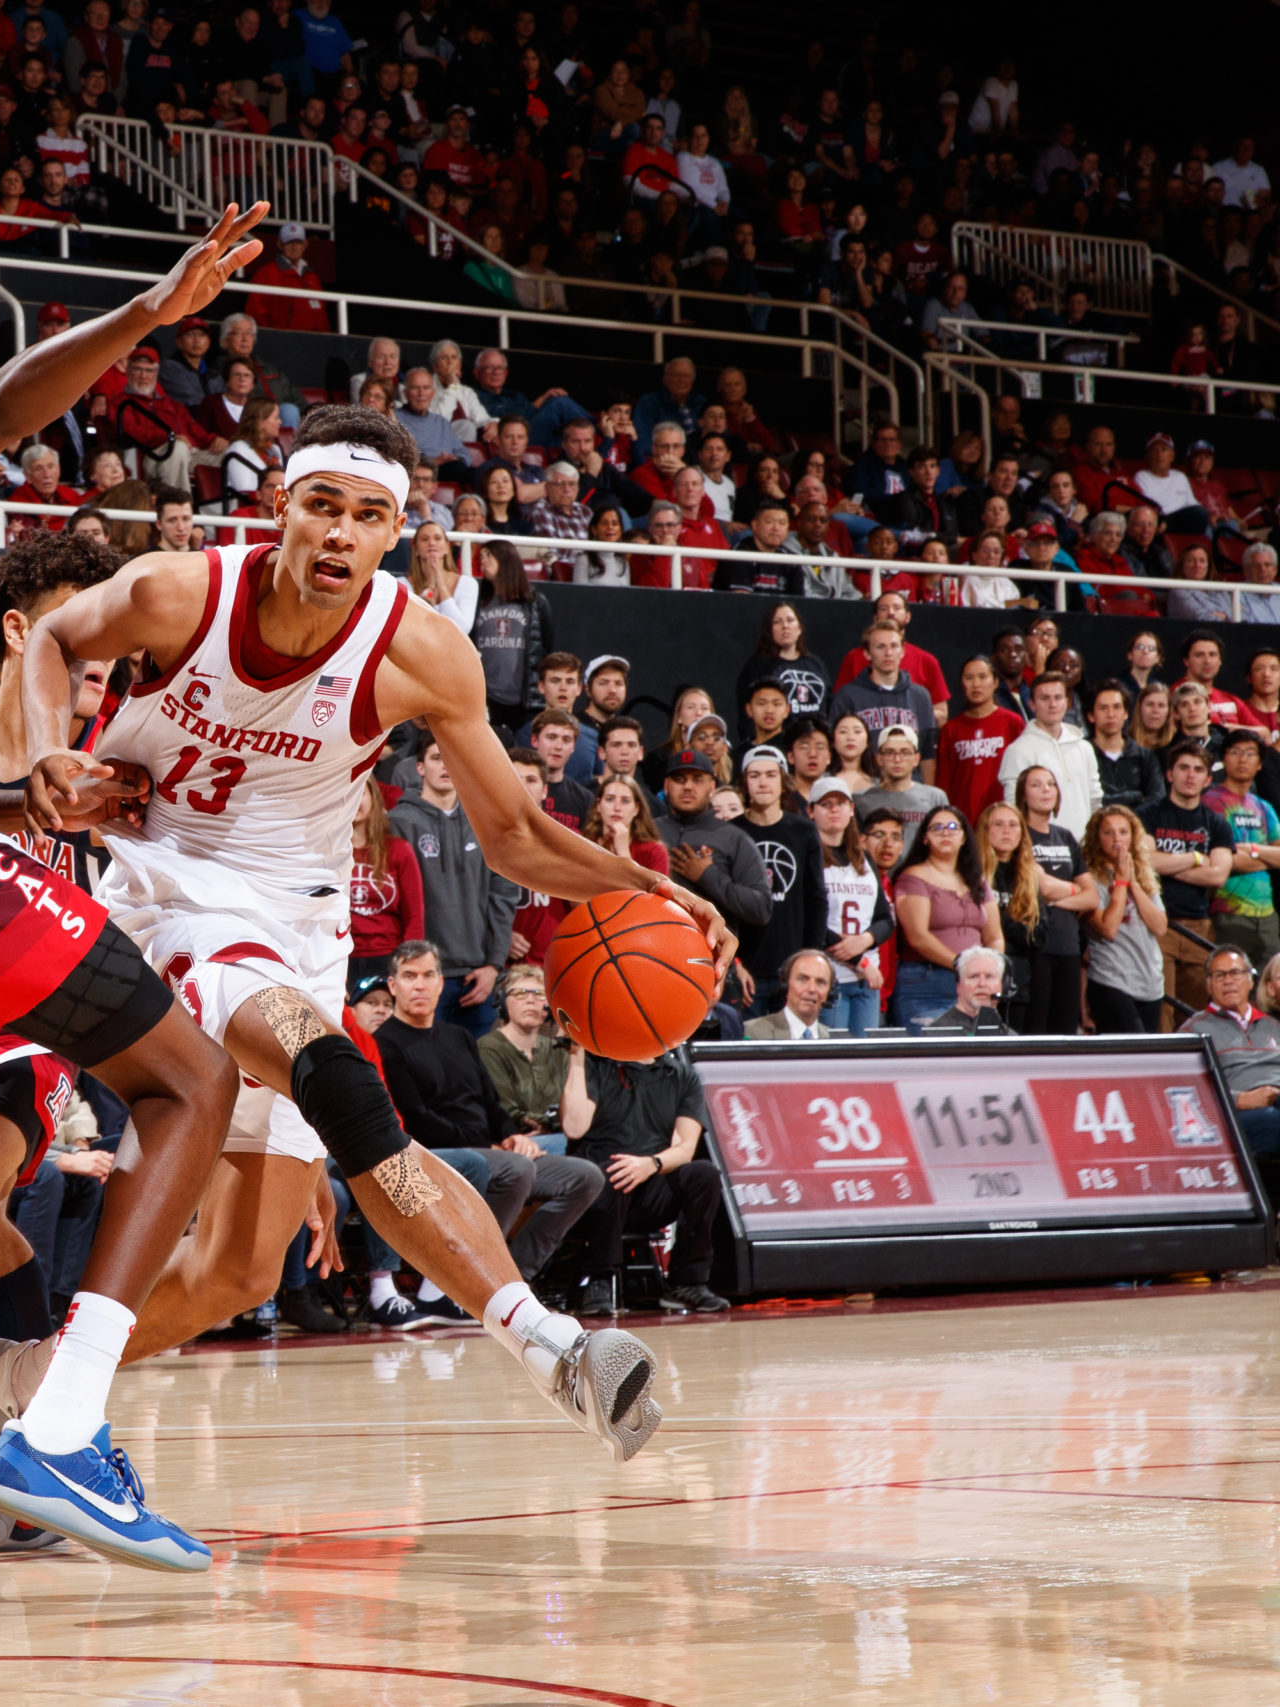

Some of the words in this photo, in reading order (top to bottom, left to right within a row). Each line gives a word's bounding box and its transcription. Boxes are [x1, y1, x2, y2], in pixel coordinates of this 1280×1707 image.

[160, 692, 323, 763] STANFORD
[156, 745, 248, 816] 13
[806, 1095, 883, 1153] 38
[911, 1090, 1040, 1149] 11:51
[1072, 1088, 1136, 1145] 44
[780, 1178, 802, 1205] 3
[830, 1178, 875, 1203] FLS
[1076, 1166, 1119, 1191] FLS
[1217, 1159, 1239, 1188] 3
